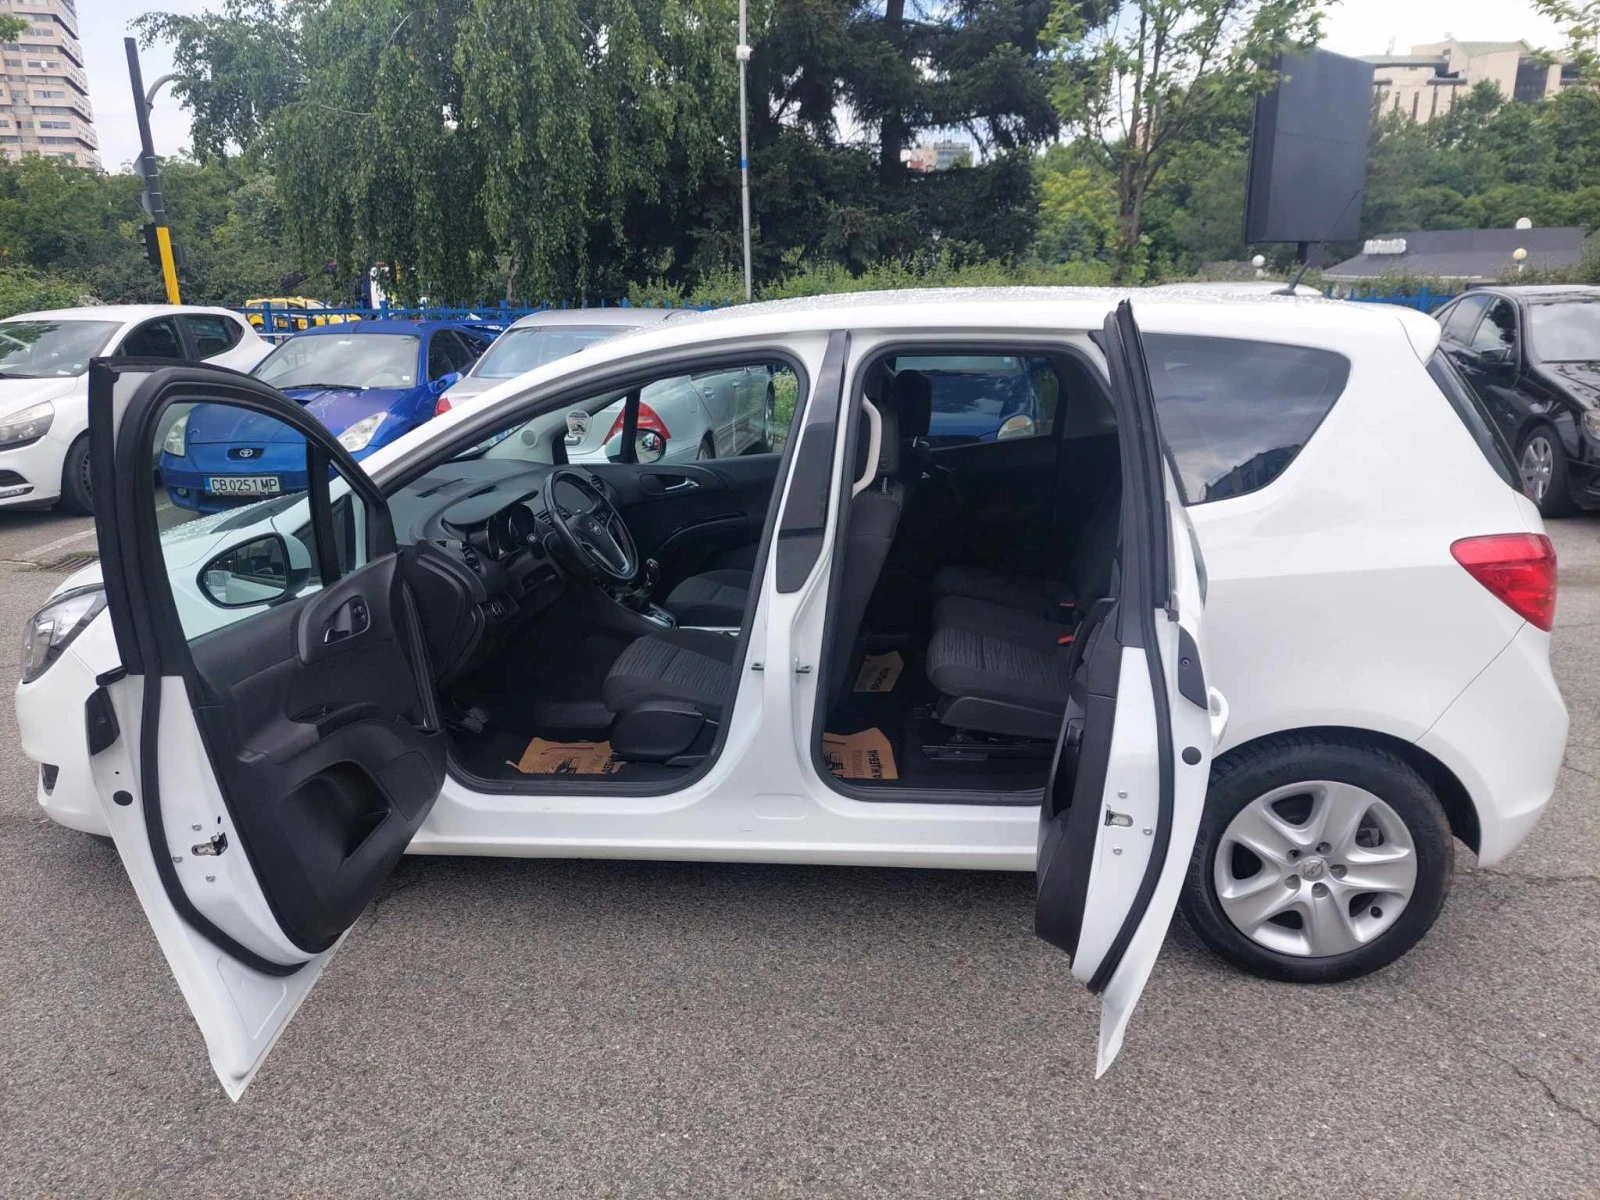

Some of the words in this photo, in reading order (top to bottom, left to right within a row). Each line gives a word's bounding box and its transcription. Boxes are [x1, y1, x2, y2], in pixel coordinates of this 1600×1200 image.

[211, 479, 228, 491] CB
[229, 479, 258, 491] 0251
[260, 478, 277, 491] MP
